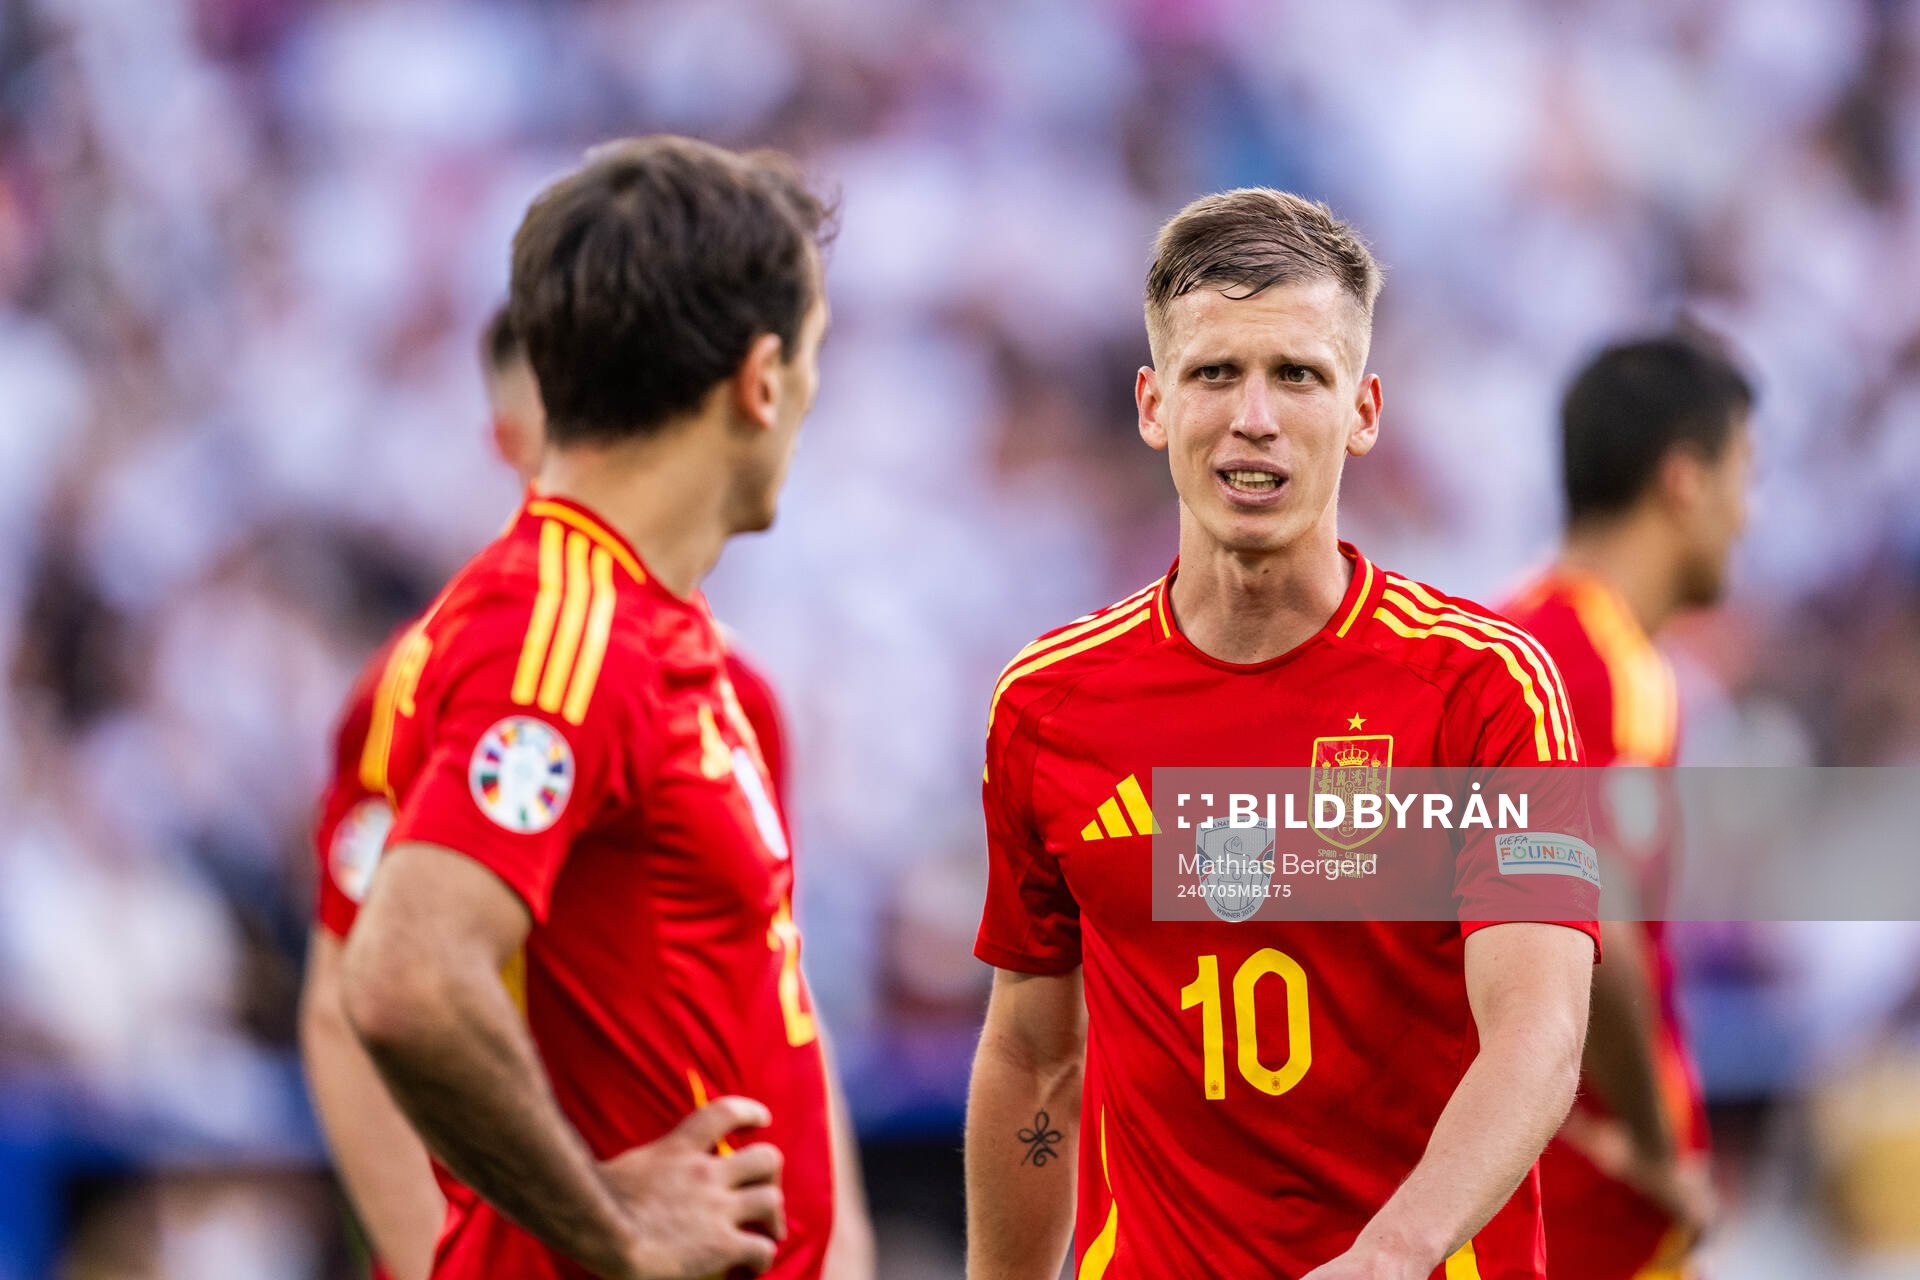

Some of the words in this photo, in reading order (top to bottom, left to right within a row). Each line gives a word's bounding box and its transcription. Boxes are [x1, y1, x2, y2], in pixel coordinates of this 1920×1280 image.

[1500, 835, 1528, 846] UEFA
[1317, 848, 1337, 859] SPAIN
[1216, 906, 1241, 919] WINNER
[1181, 947, 1312, 1100] 10
